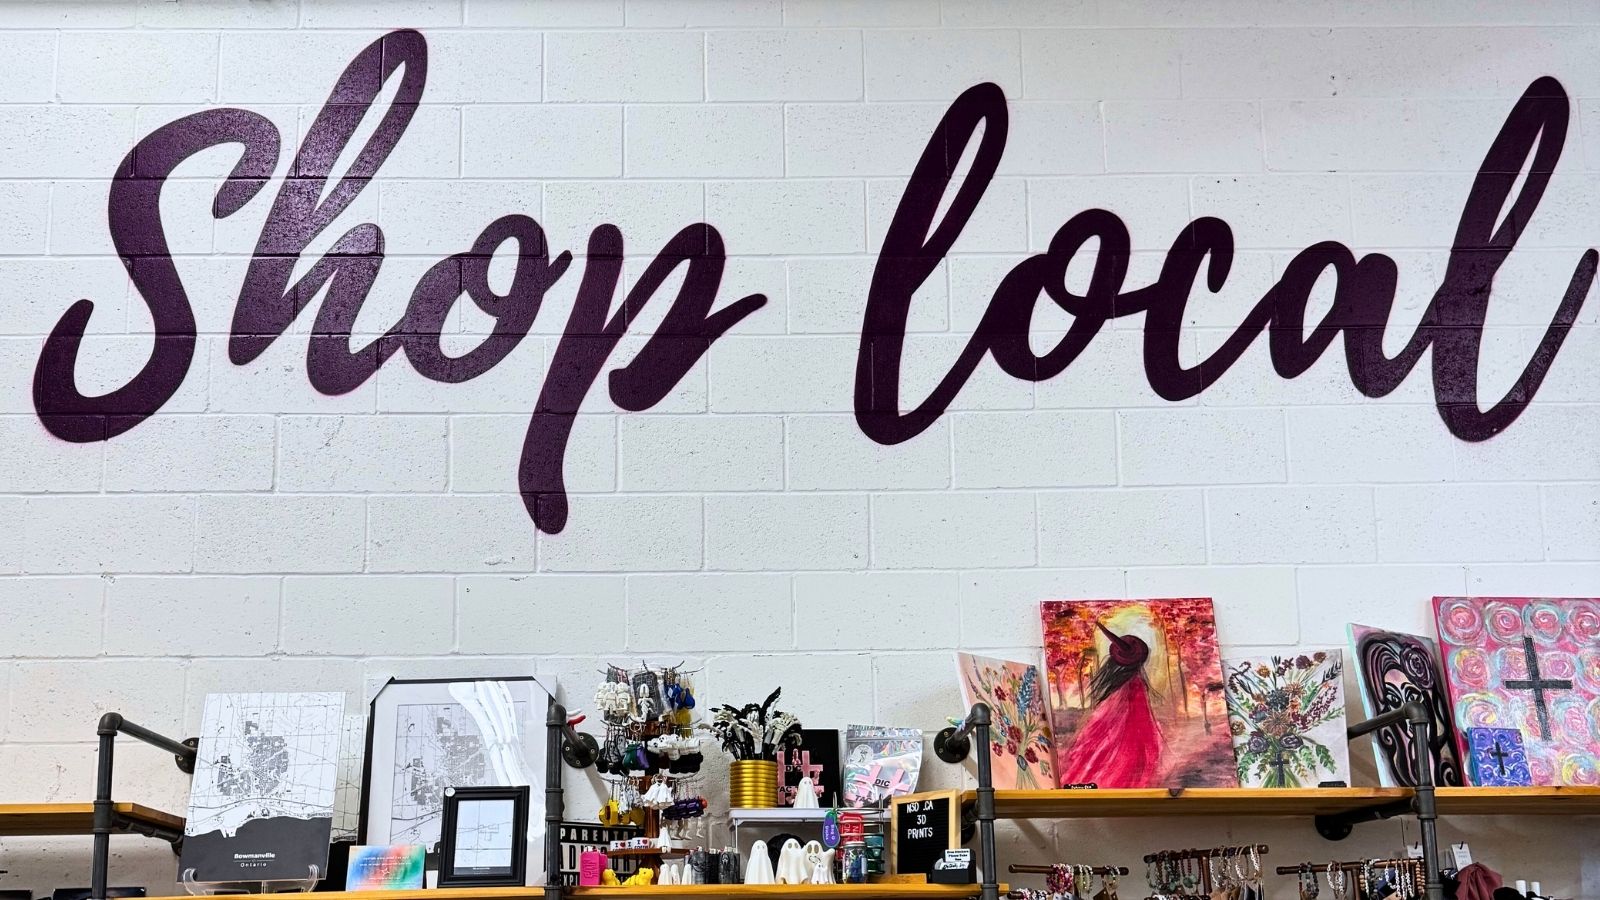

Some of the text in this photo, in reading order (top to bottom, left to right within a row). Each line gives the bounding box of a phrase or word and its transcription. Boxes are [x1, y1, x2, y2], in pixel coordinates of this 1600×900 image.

[33, 28, 1599, 534] Shop local
[917, 815, 927, 825] 3D
[907, 827, 934, 839] PRINTS
